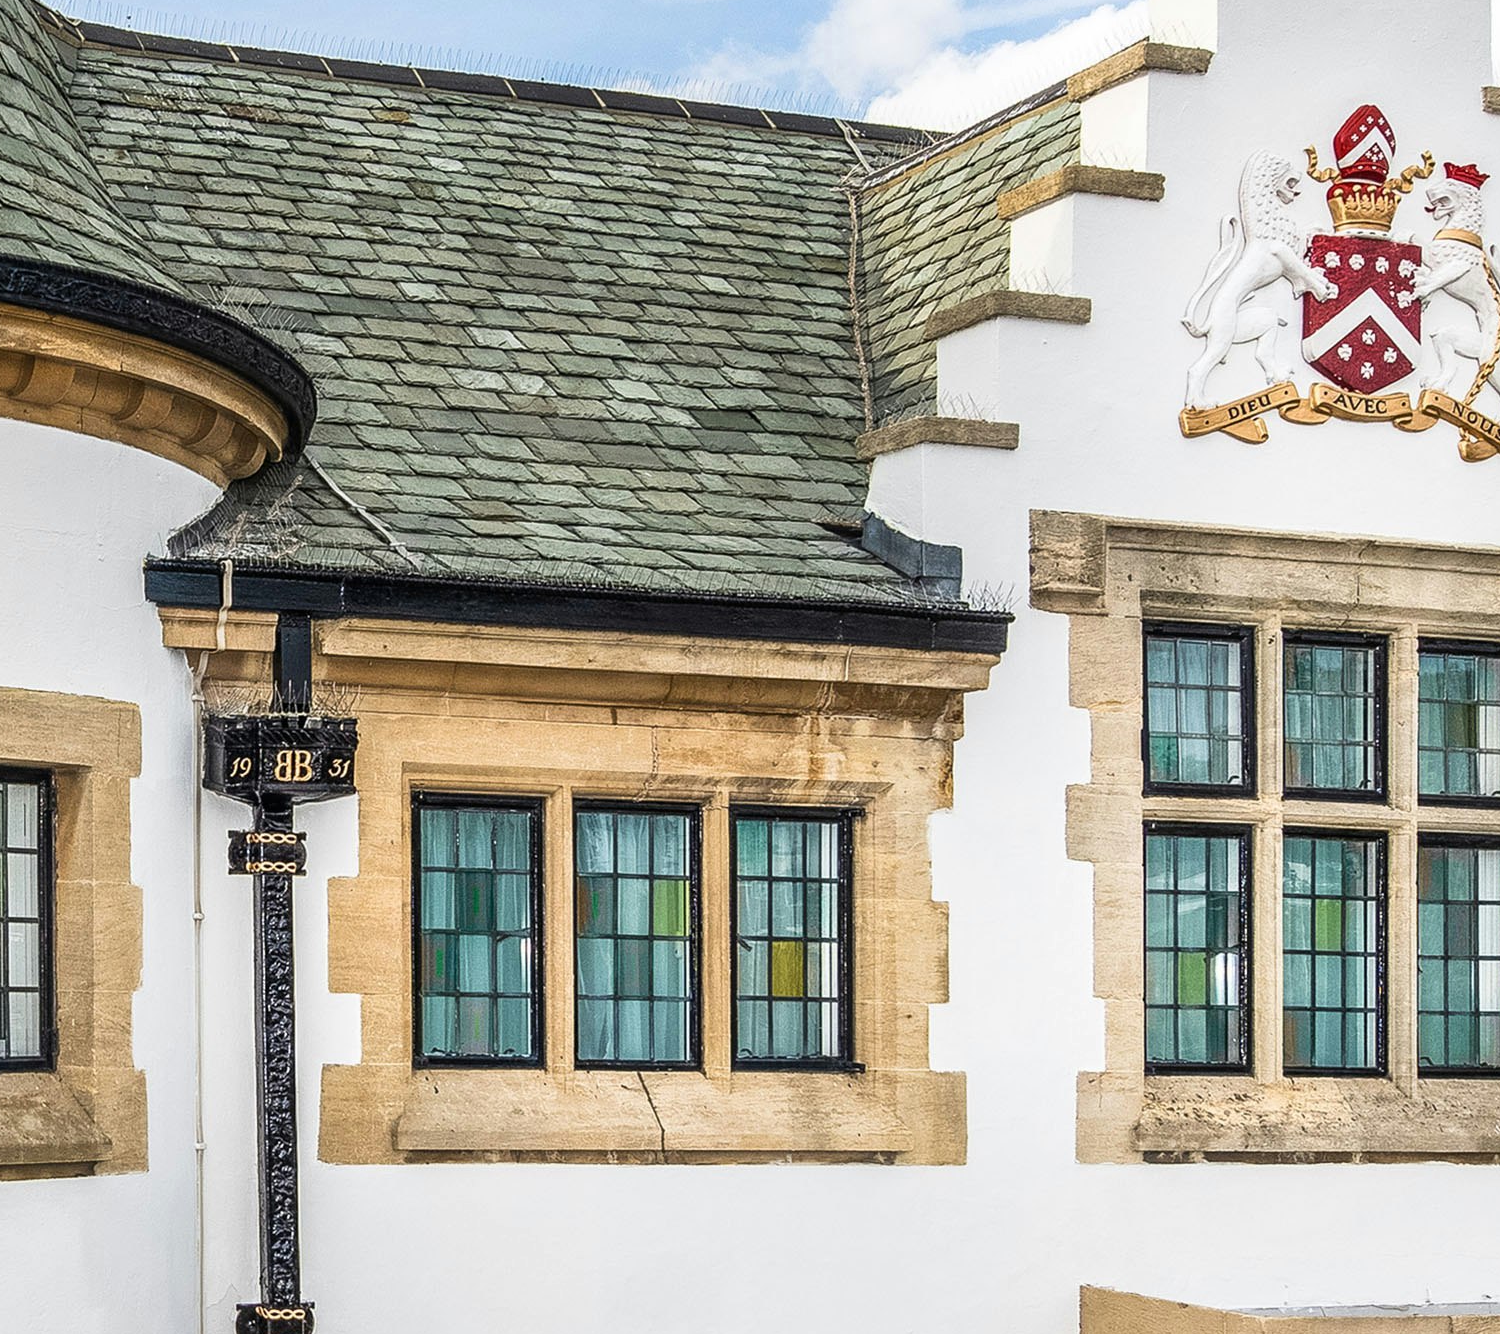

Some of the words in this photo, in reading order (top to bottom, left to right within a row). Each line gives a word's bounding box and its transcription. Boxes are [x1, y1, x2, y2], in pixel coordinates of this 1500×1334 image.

[1227, 393, 1272, 420] DIEU
[1332, 393, 1388, 414] AVEC
[229, 756, 252, 778] 19
[327, 758, 351, 778] 31
